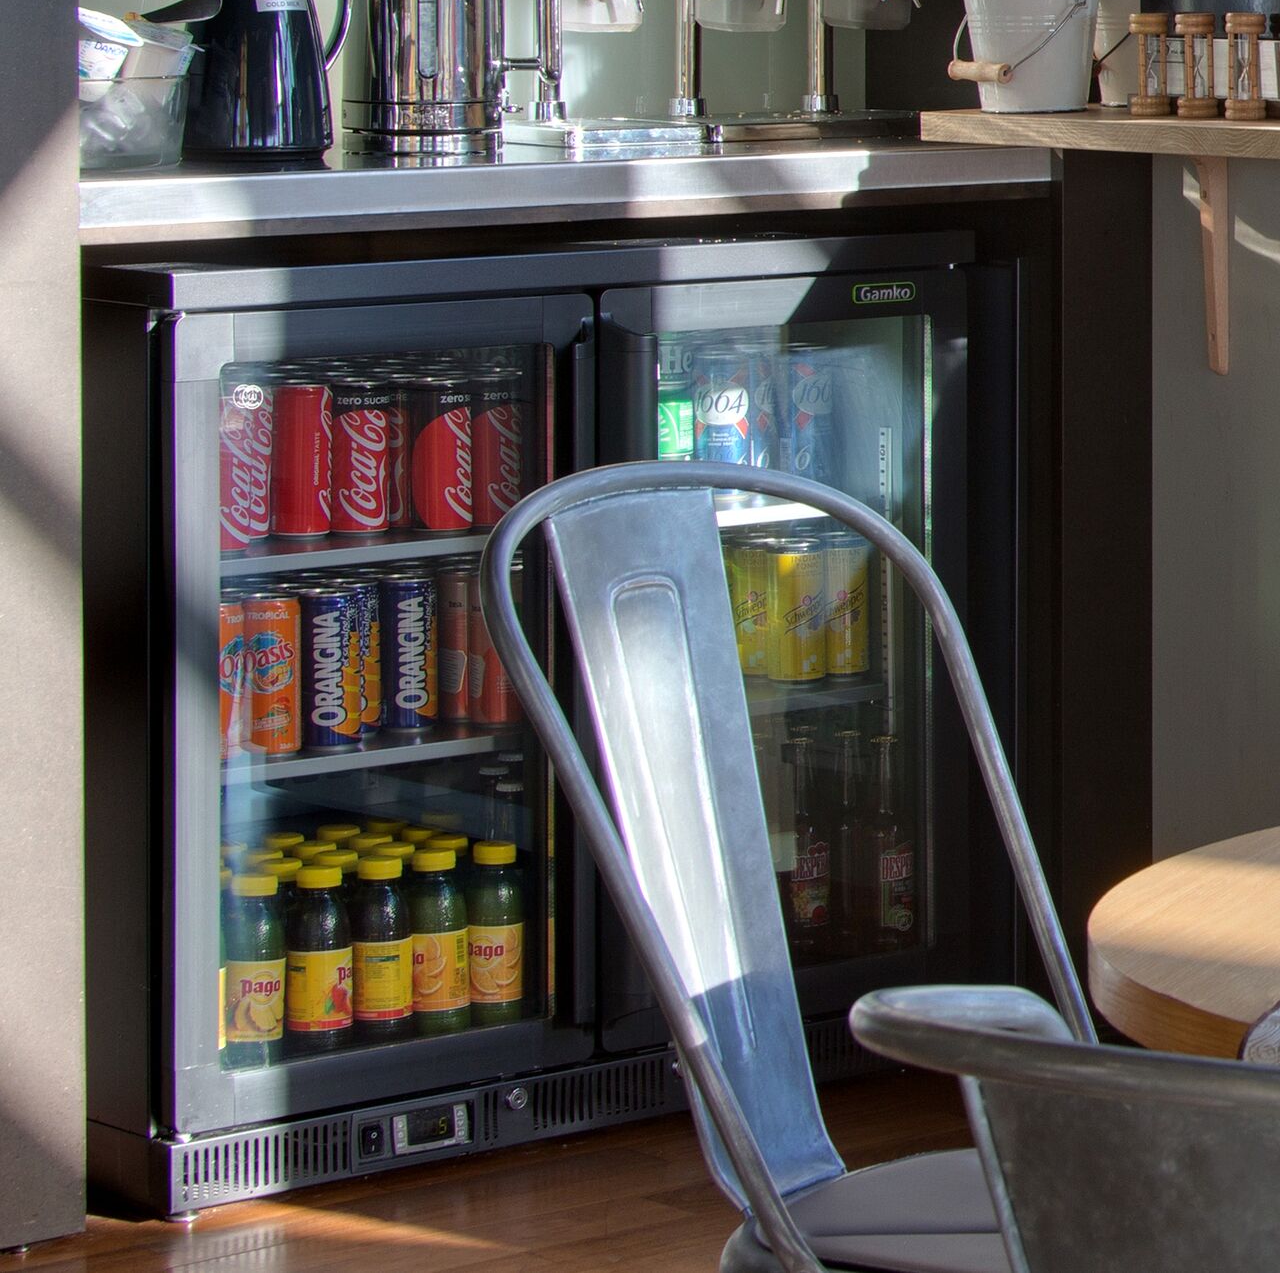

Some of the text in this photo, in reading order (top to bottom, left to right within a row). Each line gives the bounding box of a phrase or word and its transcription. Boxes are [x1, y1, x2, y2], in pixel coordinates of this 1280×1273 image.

[861, 284, 910, 301] Gamko
[337, 396, 362, 405] zero
[440, 394, 463, 403] zero
[395, 596, 429, 709] ORANGINA
[311, 611, 347, 727] ORANGINA
